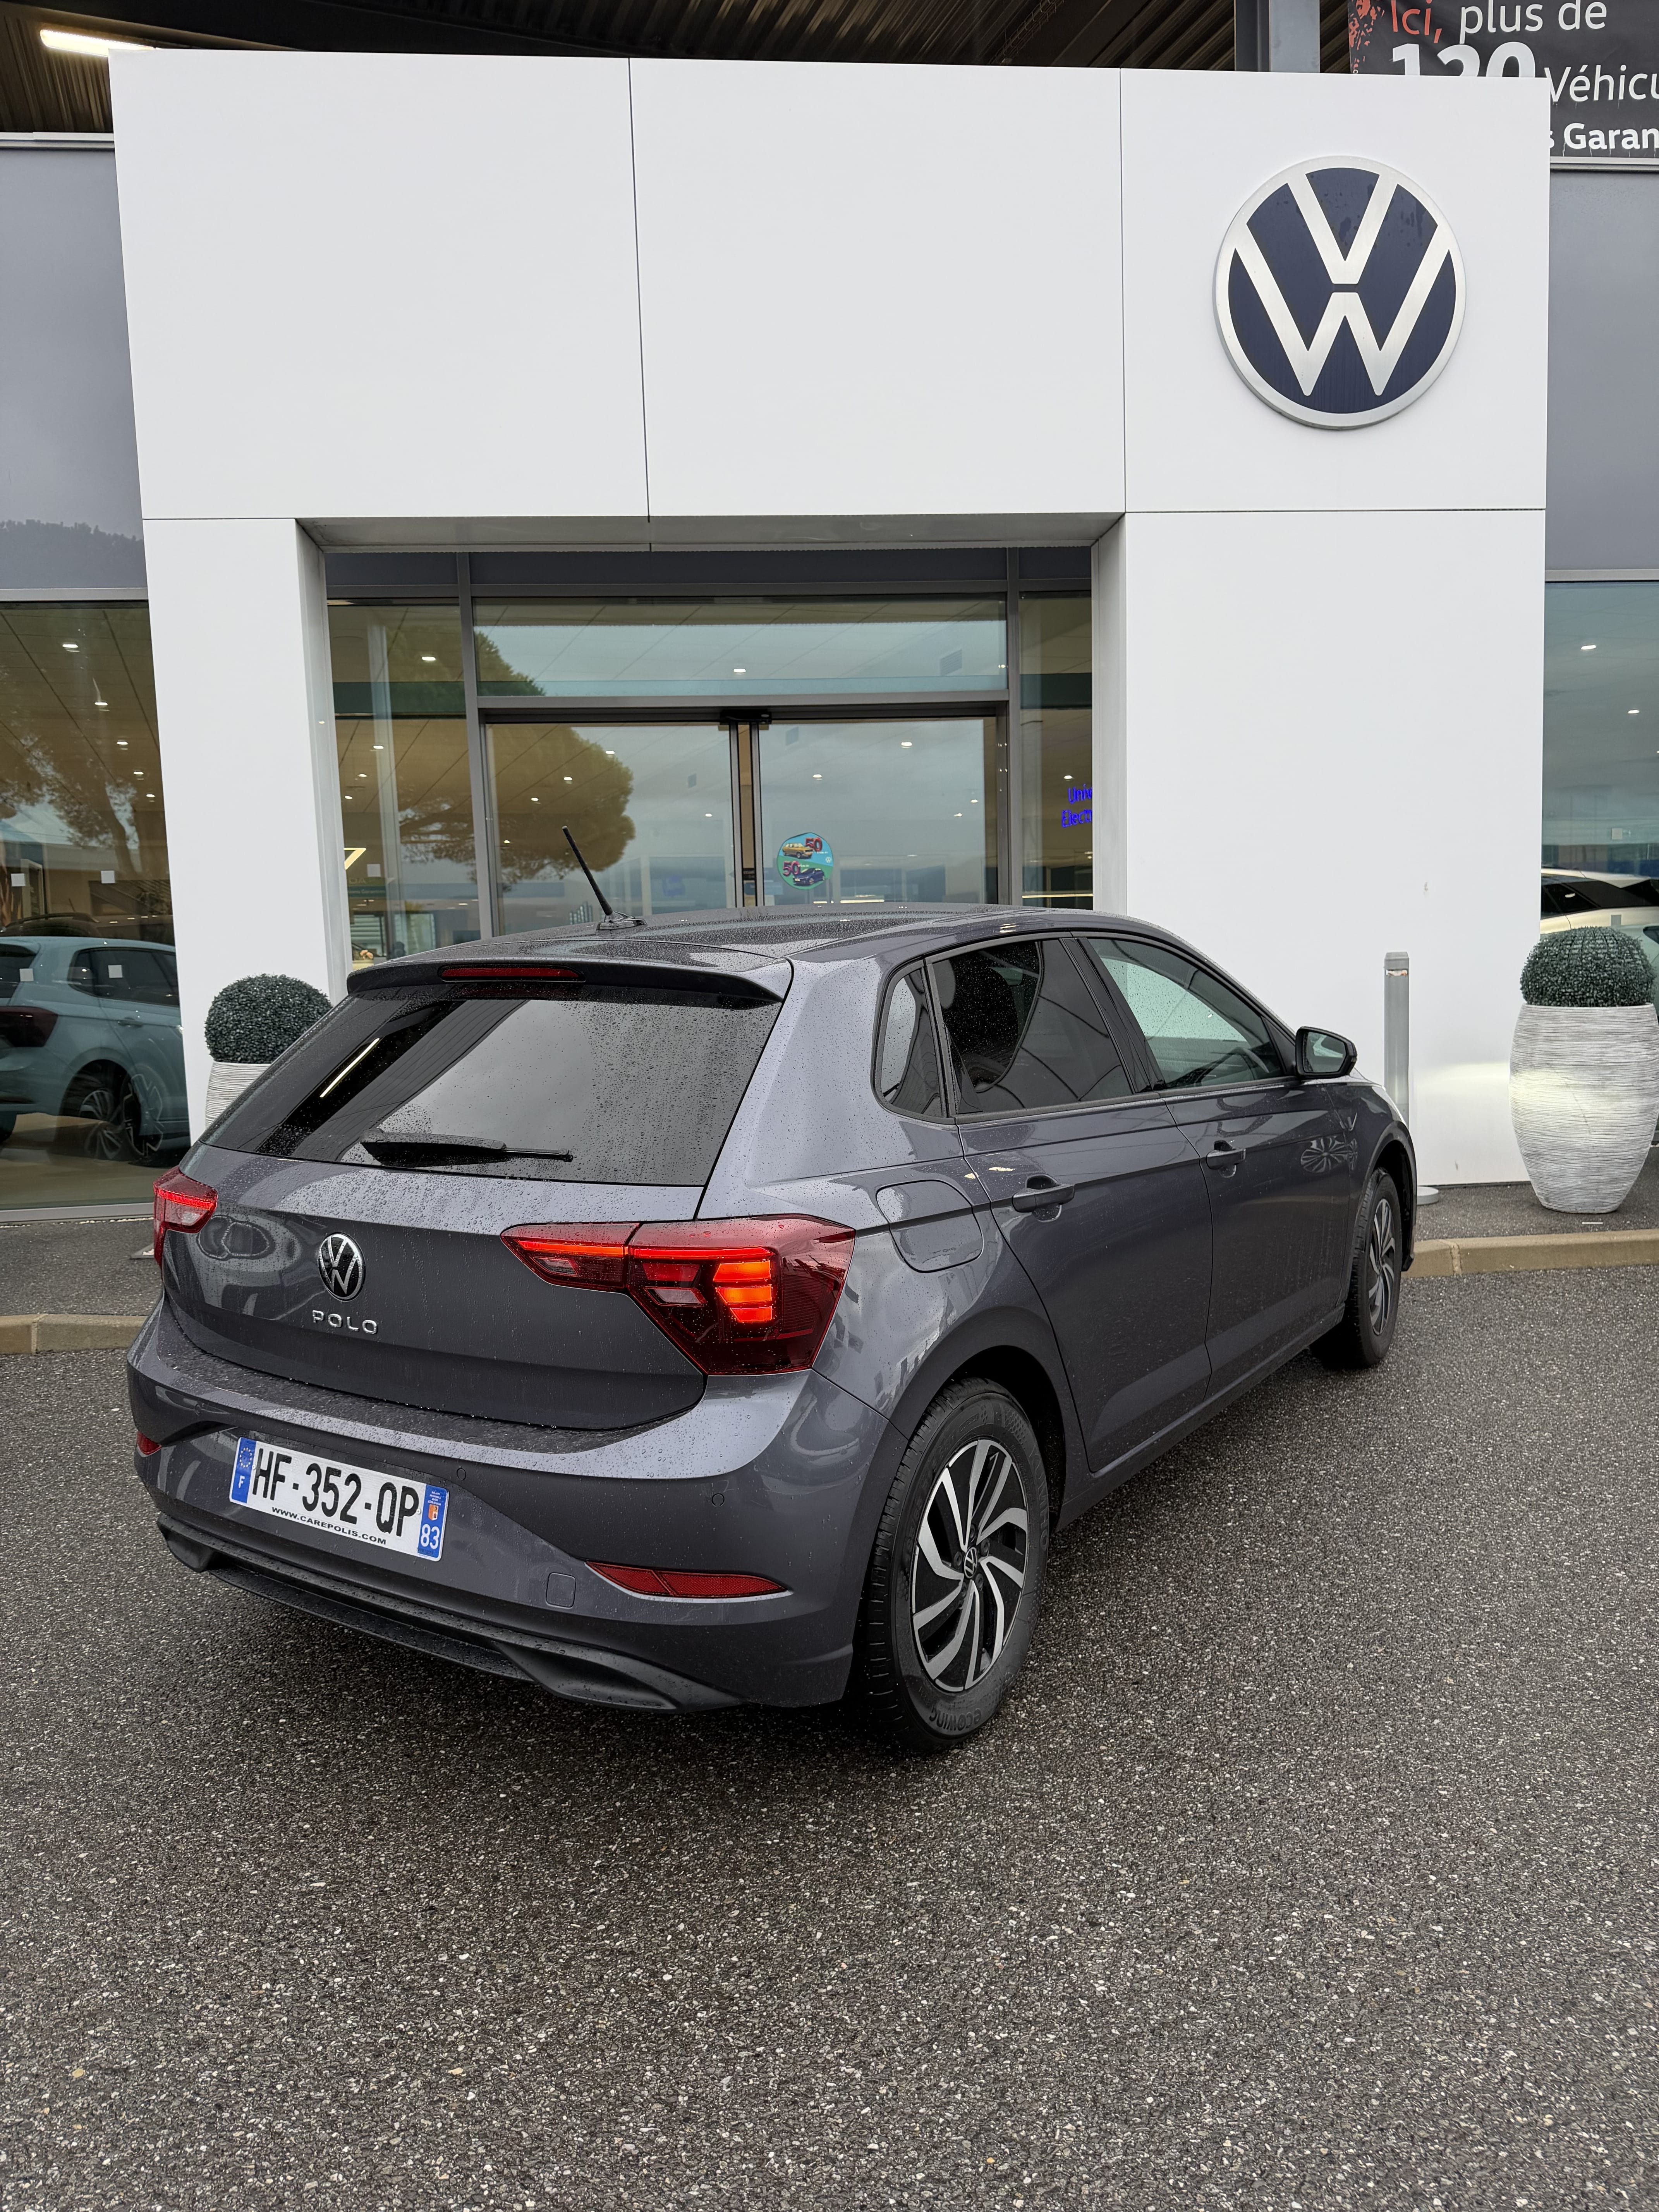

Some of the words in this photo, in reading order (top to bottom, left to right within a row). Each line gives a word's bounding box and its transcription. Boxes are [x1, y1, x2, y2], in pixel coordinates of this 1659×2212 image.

[1391, 0, 1442, 43] Ici,
[1459, 0, 1543, 44] plus
[1558, 0, 1607, 30] de
[1564, 123, 1659, 149] Garan
[805, 837, 822, 852] 50
[783, 860, 800, 877] 50
[312, 1310, 378, 1334] POLO
[237, 1475, 245, 1489] F
[252, 1448, 419, 1537] HF-352-QP
[420, 1524, 440, 1549] 83
